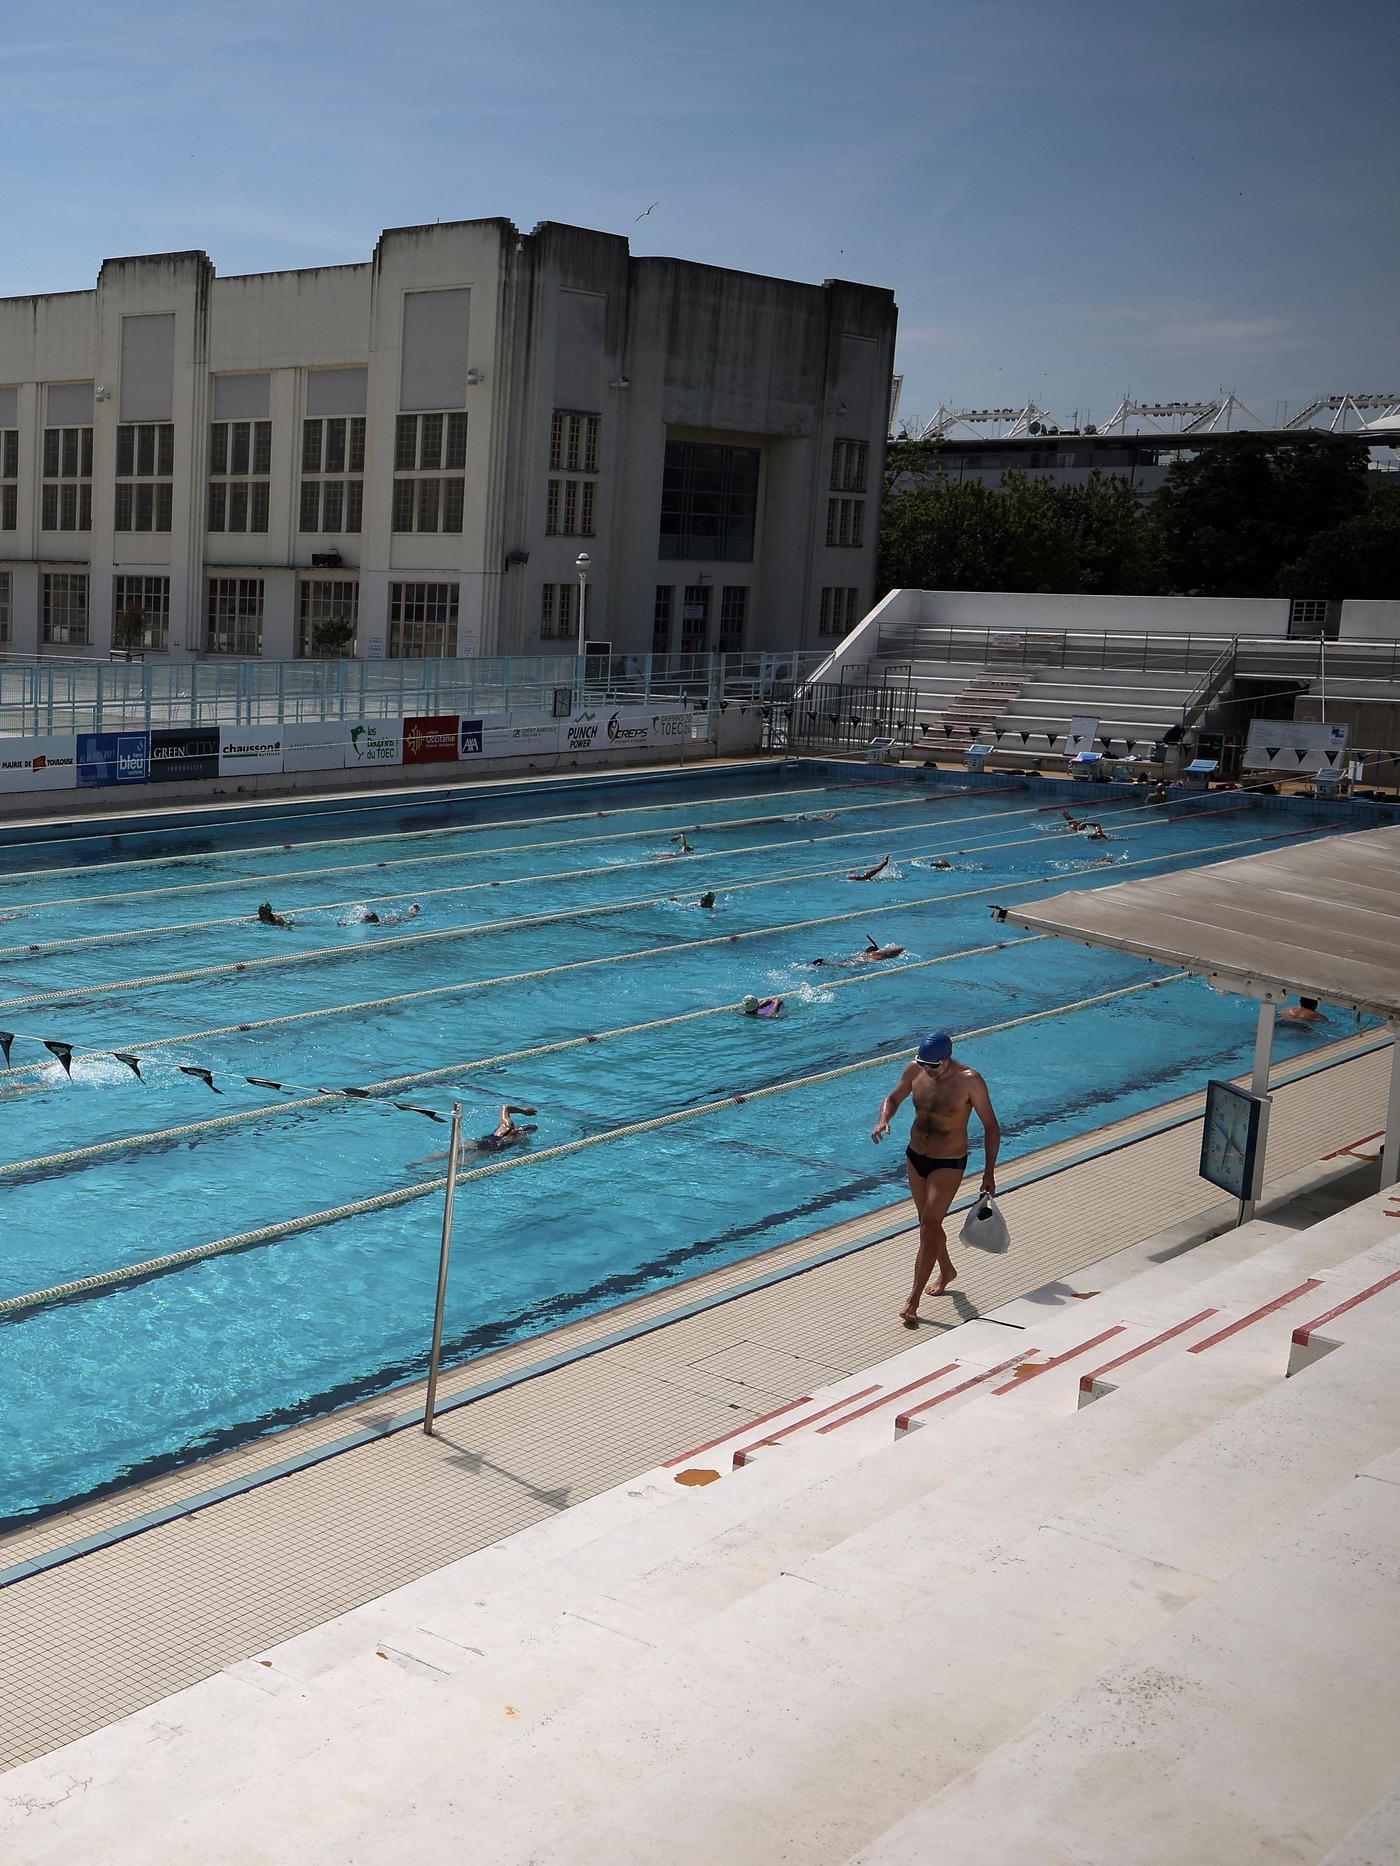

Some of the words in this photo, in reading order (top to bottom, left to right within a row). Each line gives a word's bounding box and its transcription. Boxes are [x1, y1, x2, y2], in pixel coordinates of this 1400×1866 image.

[367, 726, 377, 736] les
[567, 725, 598, 740] PUNCH
[615, 728, 648, 739] CREPS
[661, 721, 683, 736] TOEC
[426, 735, 457, 744] Occitanie
[462, 738, 479, 752] AXA
[569, 739, 592, 749] POWER
[223, 743, 274, 754] chausson
[366, 749, 376, 759] du
[376, 747, 395, 759] TOEC
[2, 760, 23, 769] MAIRIE
[24, 760, 32, 768] DE
[47, 757, 74, 767] TOULOUSE
[120, 754, 144, 771] bleu
